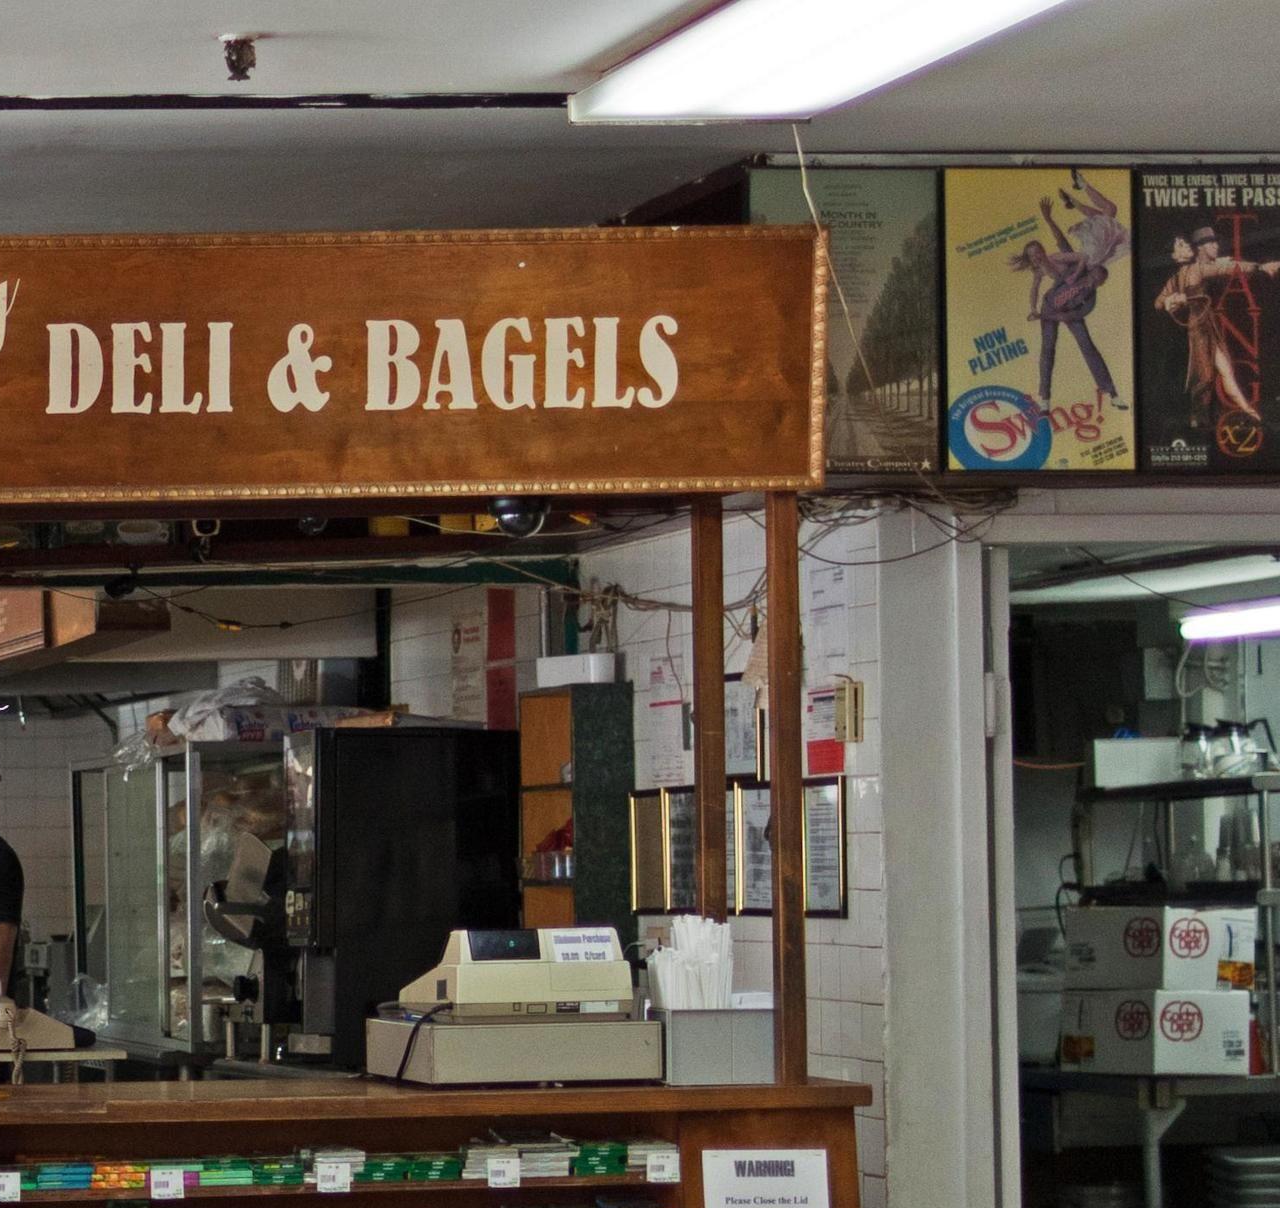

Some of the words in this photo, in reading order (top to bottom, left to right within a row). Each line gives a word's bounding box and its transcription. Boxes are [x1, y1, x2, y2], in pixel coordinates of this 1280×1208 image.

[1143, 175, 1169, 187] TWICE
[1171, 175, 1186, 186] THE
[1221, 174, 1248, 186] TWICE
[1250, 174, 1265, 186] THE
[1144, 188, 1202, 208] TWICE
[1204, 187, 1236, 207] THE
[973, 327, 1008, 354] NOW
[46, 320, 234, 415] DELI
[266, 323, 330, 413] &
[365, 315, 679, 411] BAGELS
[968, 338, 1029, 375] PLAYING
[970, 388, 1105, 457] Swing!
[734, 1160, 796, 1178] WARNING!
[725, 1196, 751, 1205] Please
[753, 1196, 776, 1205] Close
[778, 1196, 791, 1205] the
[793, 1195, 808, 1205] Lid
